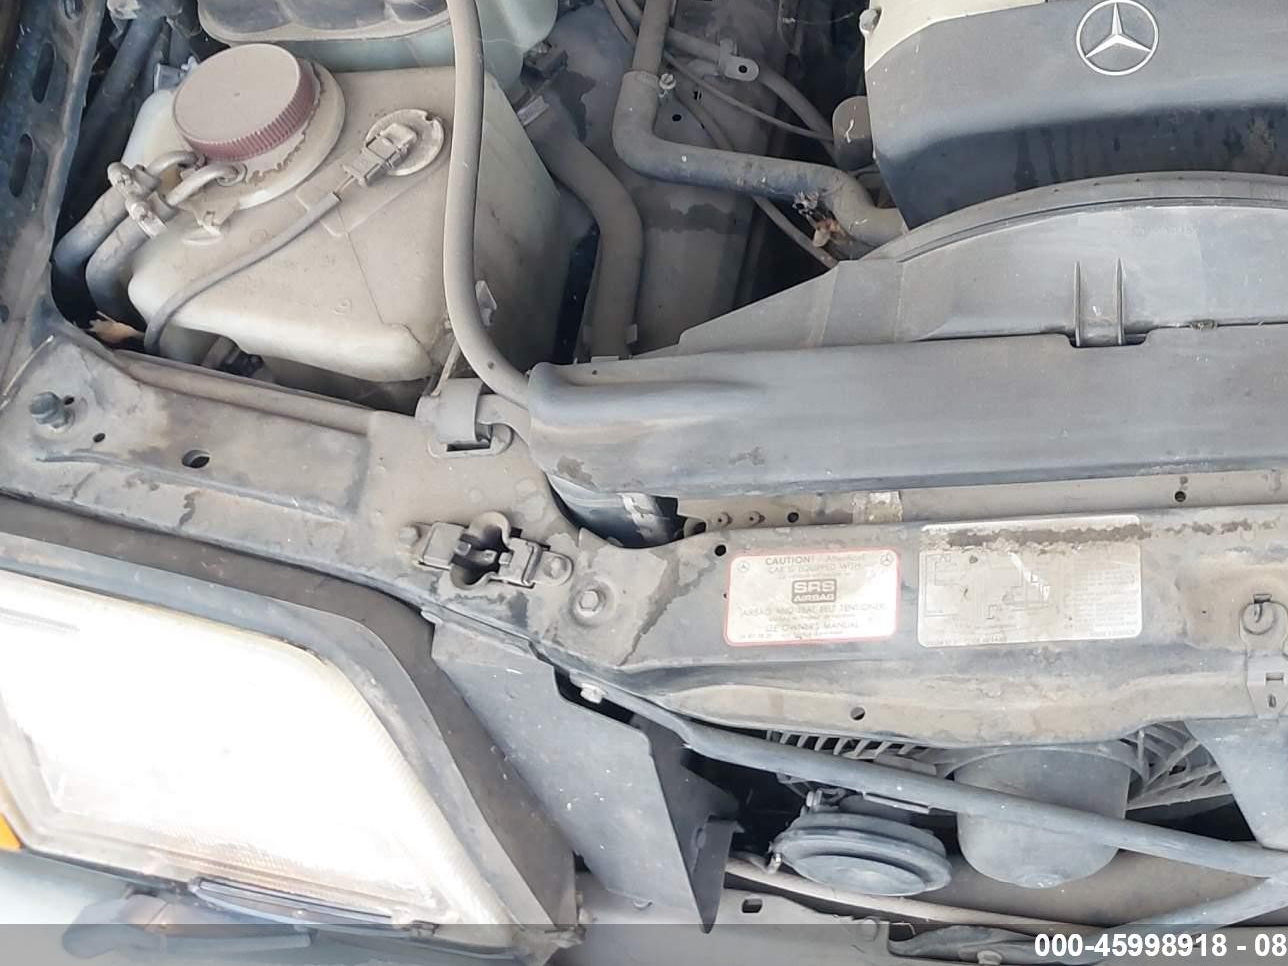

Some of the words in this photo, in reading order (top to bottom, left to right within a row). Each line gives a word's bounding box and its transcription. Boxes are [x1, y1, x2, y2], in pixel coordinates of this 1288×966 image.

[765, 555, 814, 566] CAUTION!
[794, 581, 835, 593] SRS
[793, 593, 835, 602] AIRBAG
